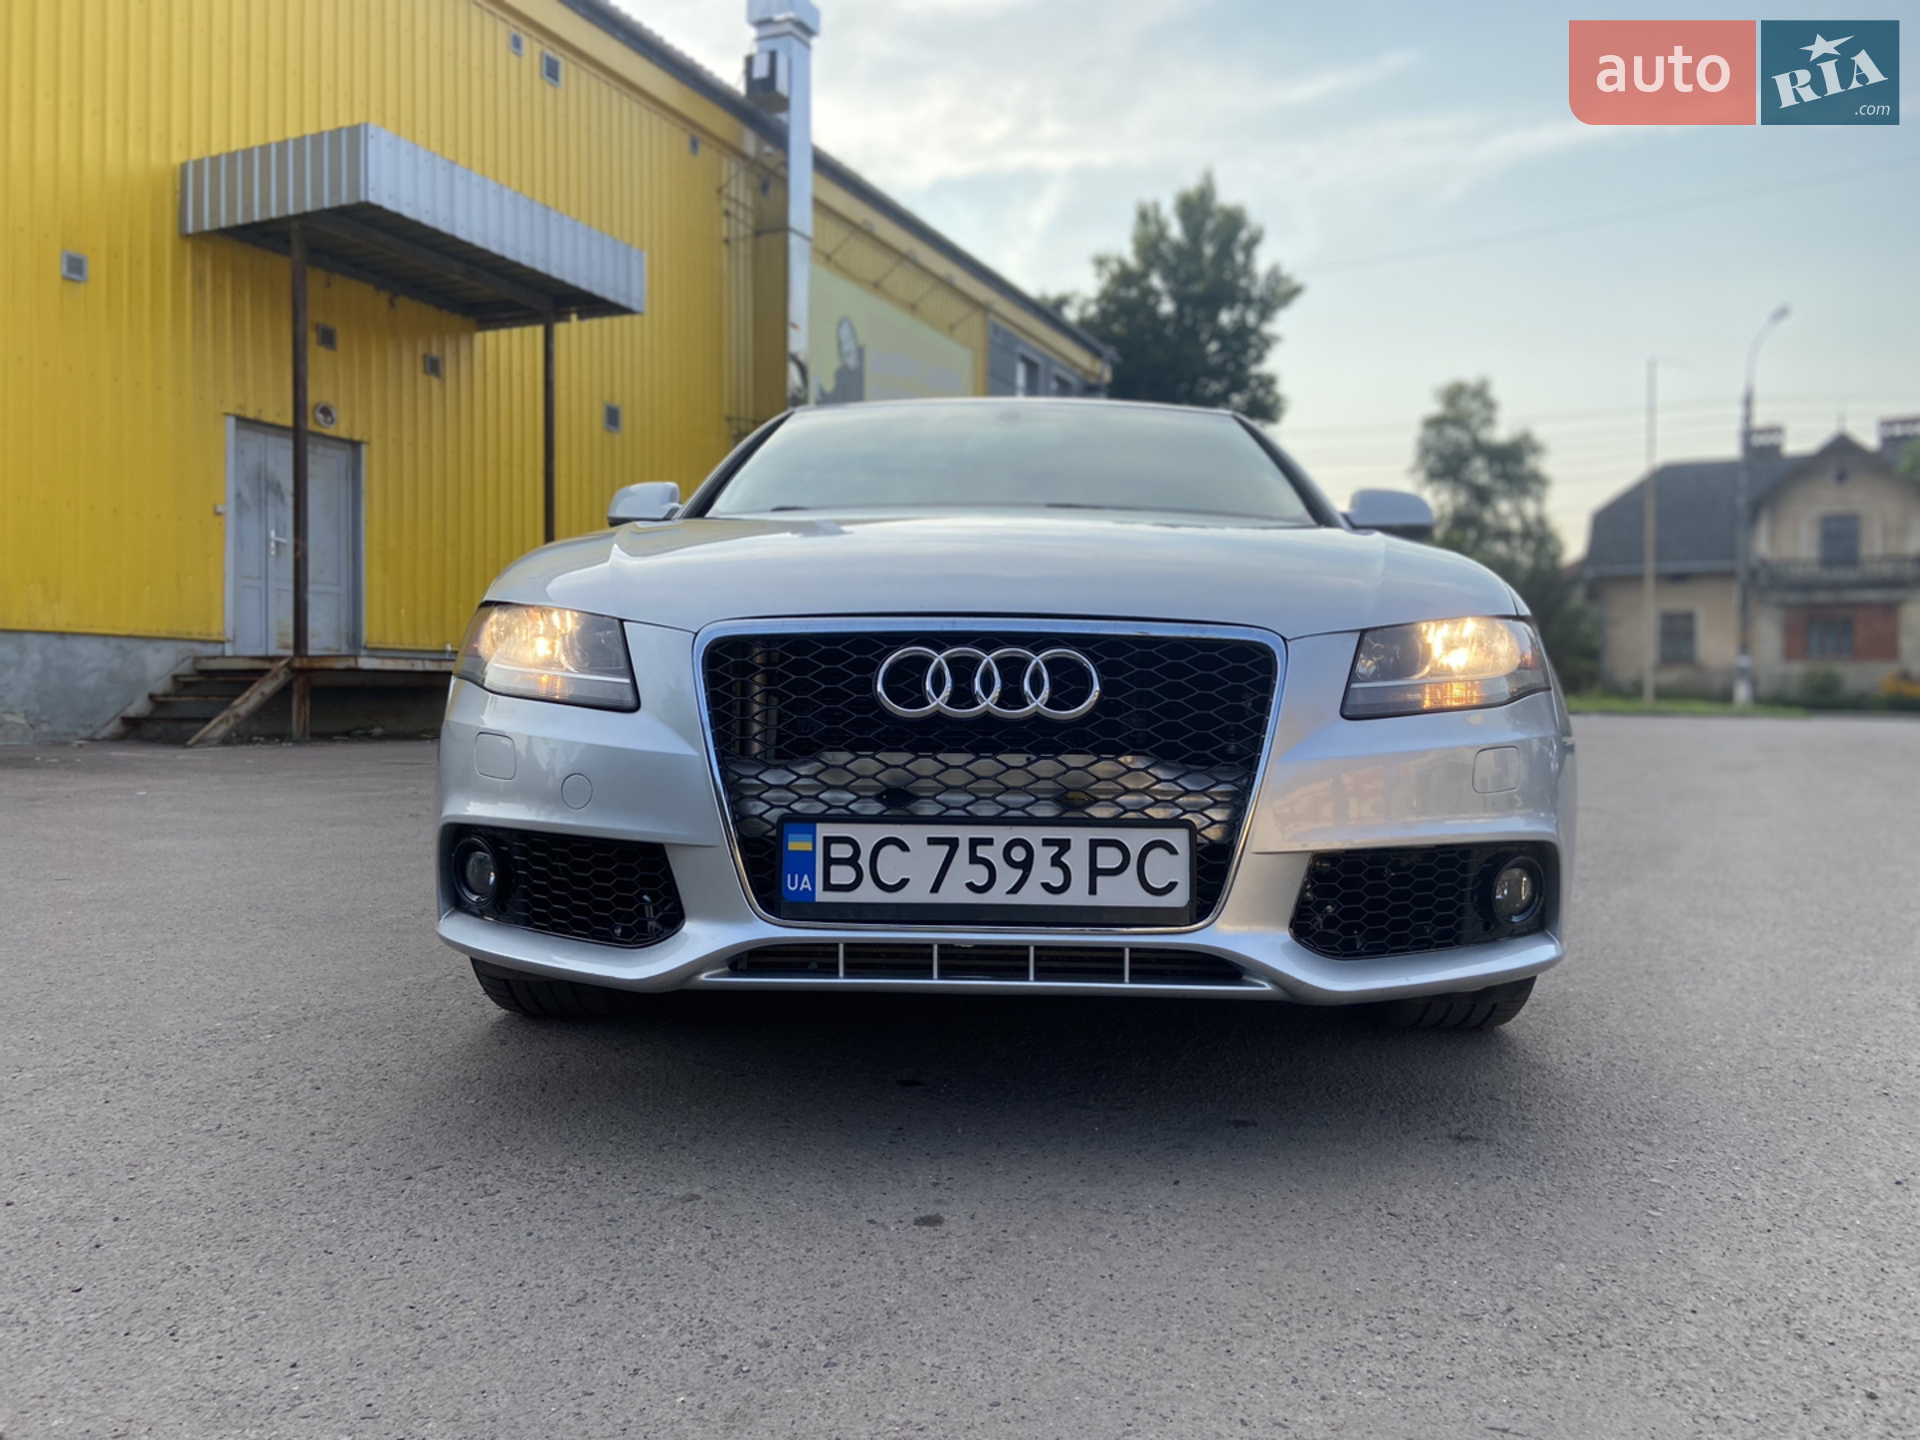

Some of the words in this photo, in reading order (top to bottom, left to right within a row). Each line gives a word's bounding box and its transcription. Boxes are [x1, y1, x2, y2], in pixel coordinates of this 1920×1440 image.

[786, 873, 812, 892] UA
[822, 835, 911, 893] BC
[926, 836, 1073, 895] 7593
[1087, 838, 1180, 897] PC
